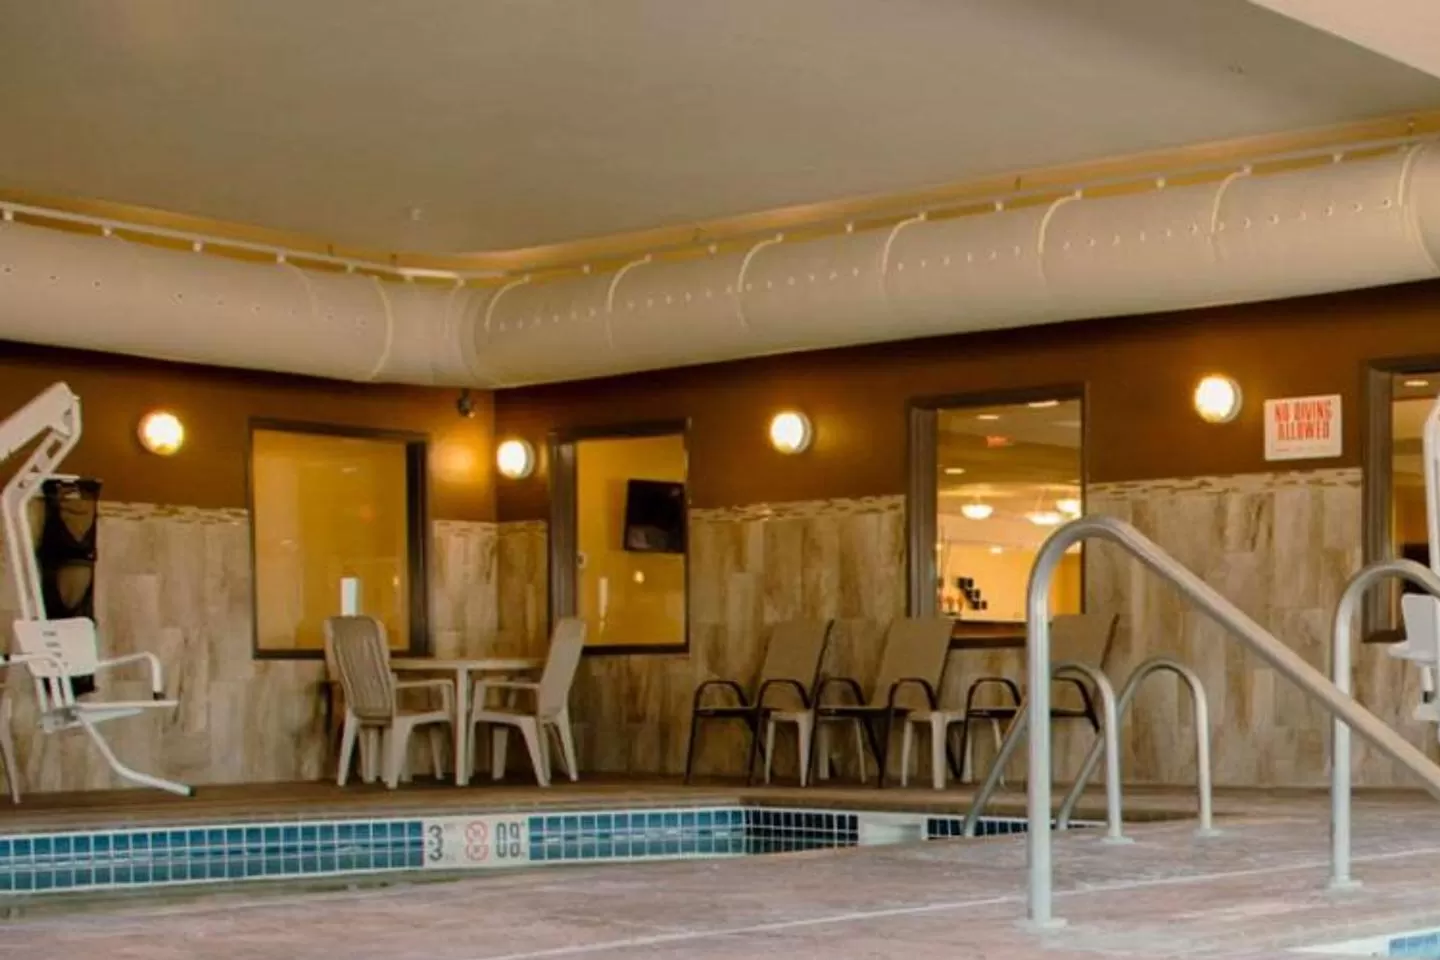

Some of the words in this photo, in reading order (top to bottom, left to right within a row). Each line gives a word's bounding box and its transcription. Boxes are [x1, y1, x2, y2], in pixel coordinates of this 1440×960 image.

[1275, 402, 1289, 422] NO
[1294, 399, 1332, 421] DIVING
[1278, 421, 1330, 441] ALLOWED
